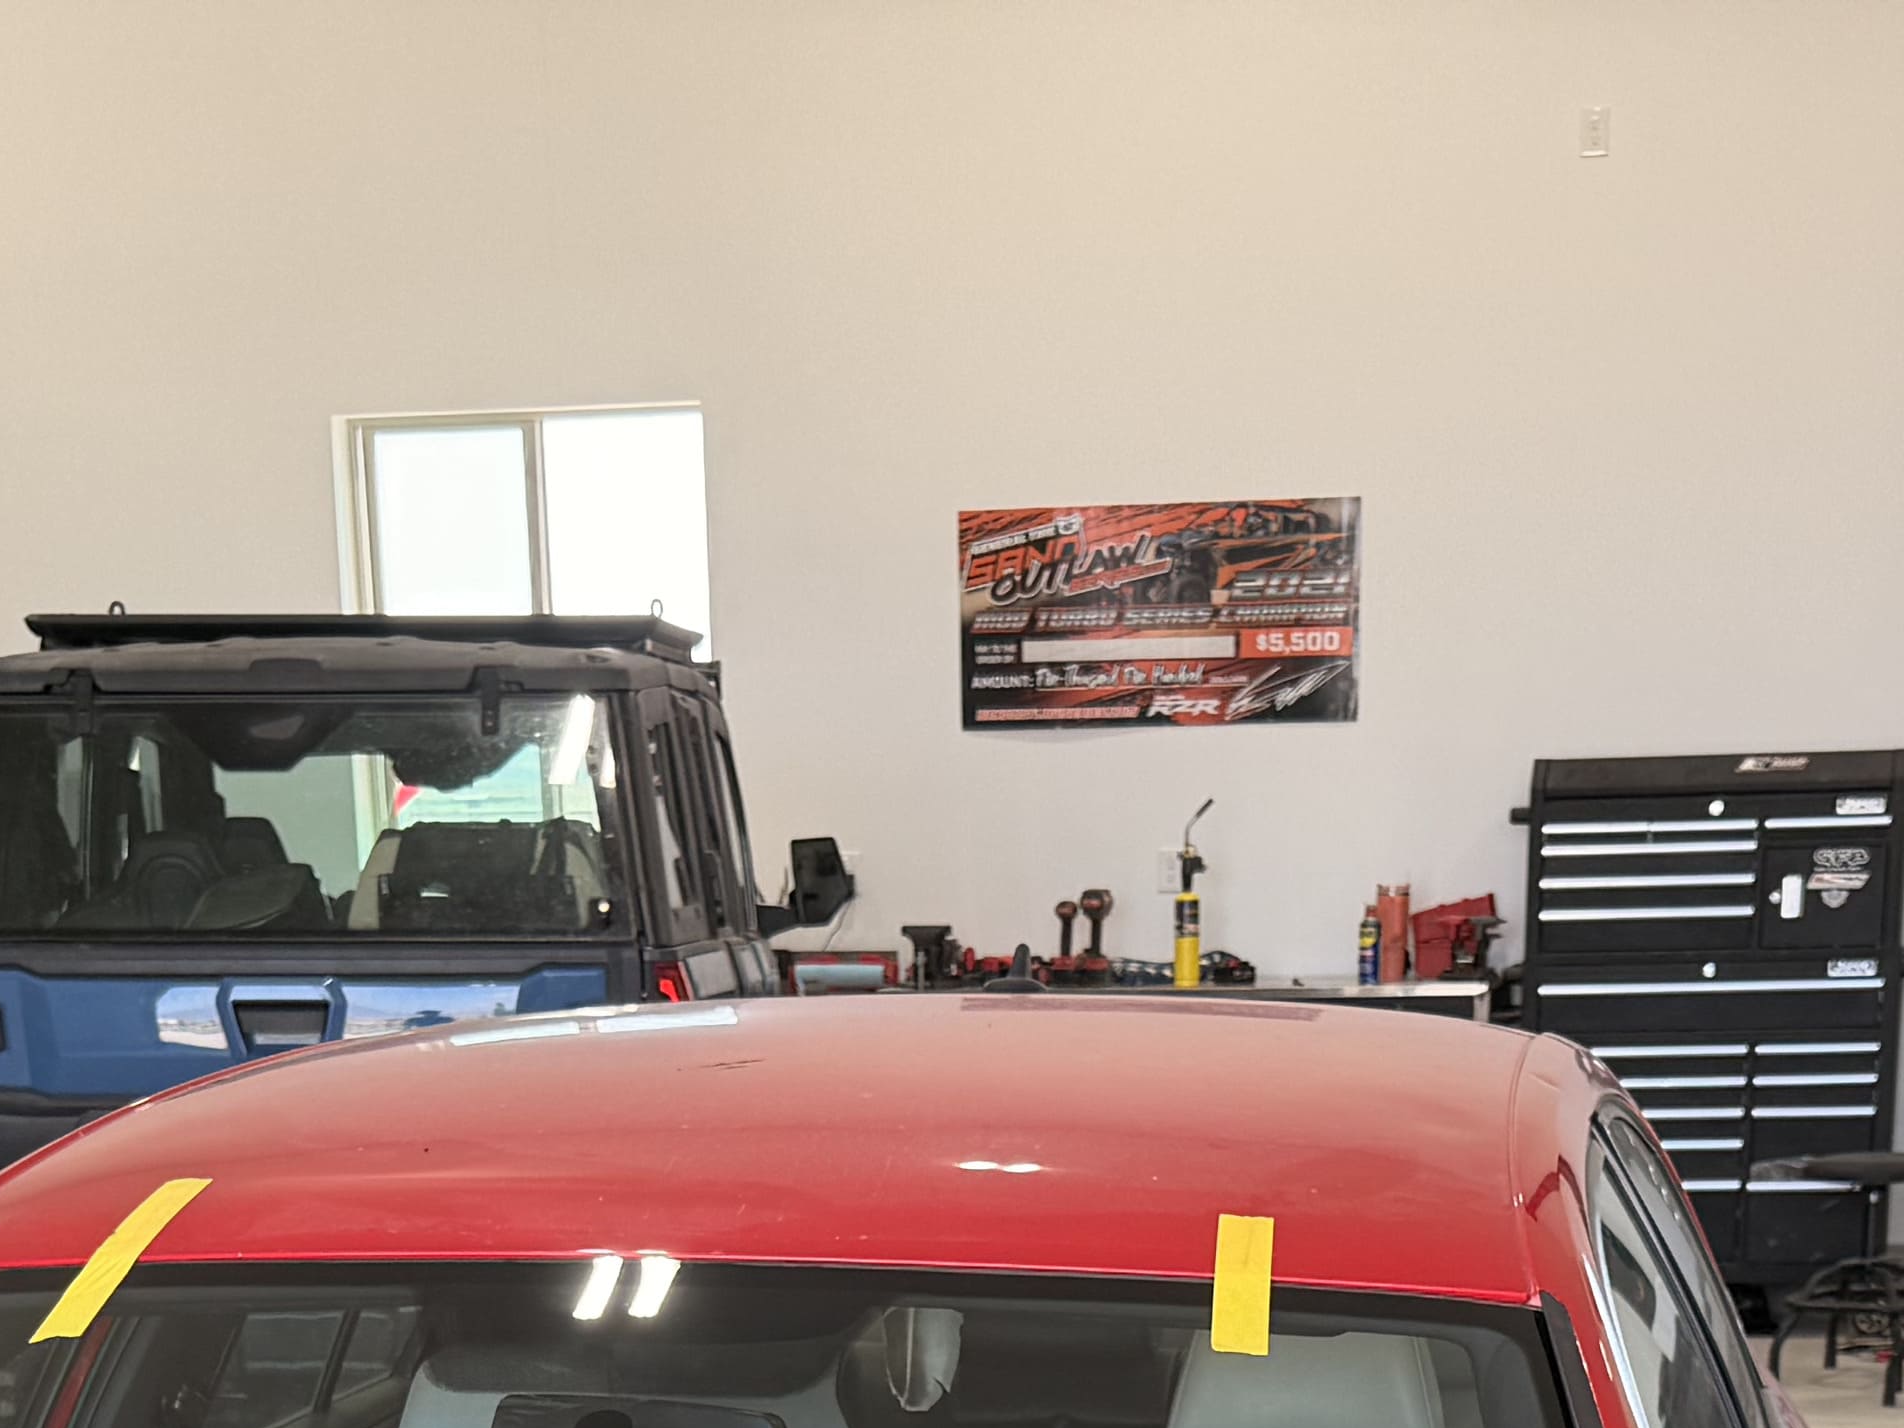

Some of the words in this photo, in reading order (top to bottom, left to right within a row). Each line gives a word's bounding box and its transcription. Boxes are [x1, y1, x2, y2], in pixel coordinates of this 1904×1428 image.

[965, 536, 1080, 588] SAND
[1230, 572, 1350, 599] 2021
[1255, 631, 1340, 653] $5,500
[971, 674, 1034, 689] AMOUNT:
[1146, 699, 1222, 717] RZR
